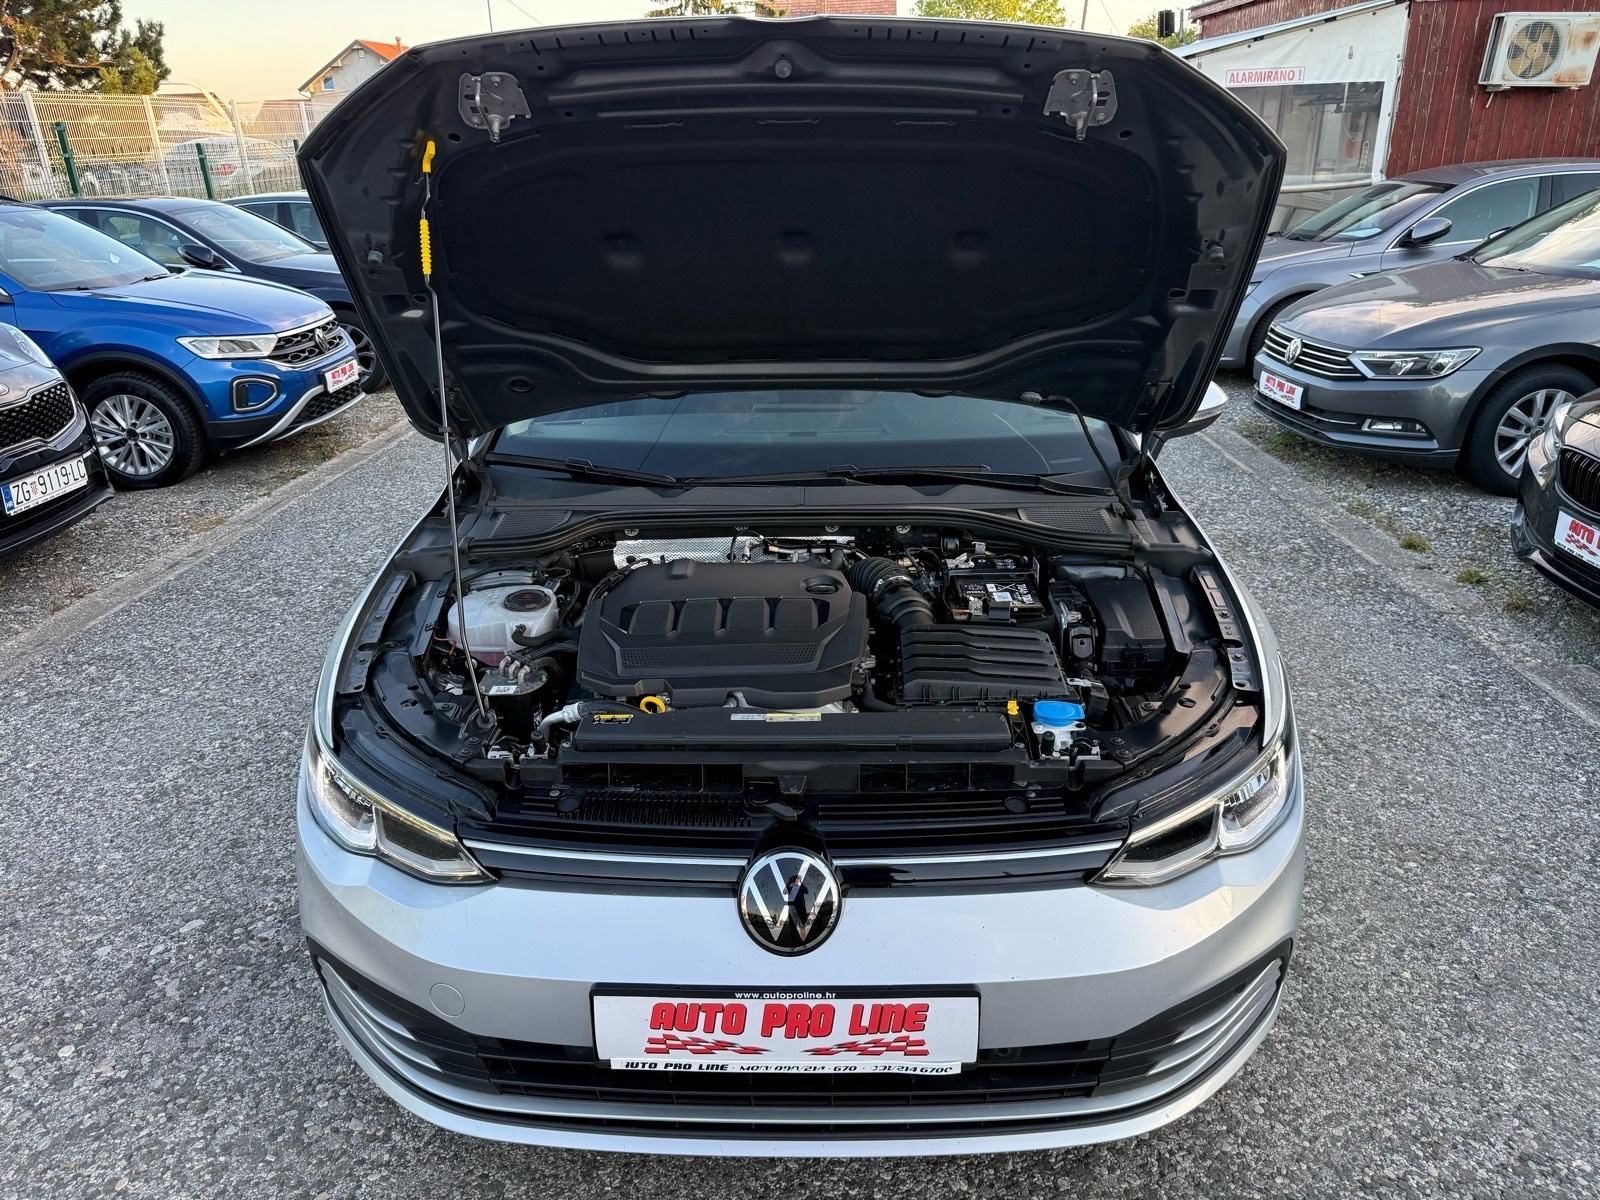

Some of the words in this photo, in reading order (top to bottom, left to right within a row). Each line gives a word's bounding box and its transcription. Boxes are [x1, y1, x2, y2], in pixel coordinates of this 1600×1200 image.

[1228, 69, 1295, 84] ALARMIRANO
[12, 481, 31, 506] ZG
[1568, 519, 1595, 545] AUTO
[734, 991, 837, 1001] www.autoproline.hr
[650, 1003, 748, 1036] AUTO
[761, 1003, 836, 1039] PRO
[848, 1003, 930, 1036] LINE
[663, 1062, 692, 1070] PRO
[698, 1063, 729, 1071] LINE
